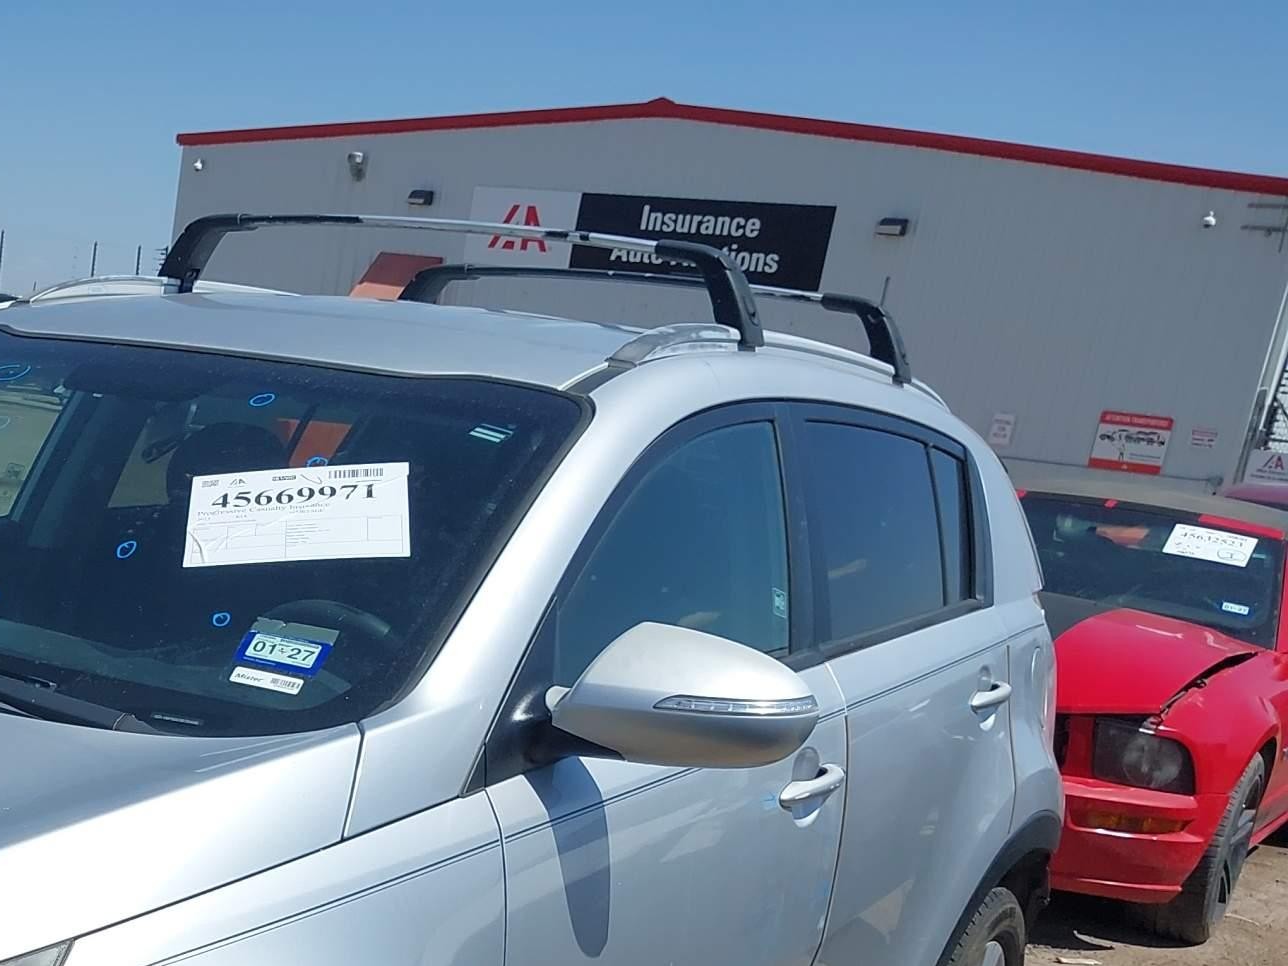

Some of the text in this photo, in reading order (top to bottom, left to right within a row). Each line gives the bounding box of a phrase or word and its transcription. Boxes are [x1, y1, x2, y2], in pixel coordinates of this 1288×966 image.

[639, 204, 762, 238] Insurance
[211, 484, 376, 508] 45669971
[252, 640, 278, 655] 01
[286, 647, 316, 662] 27
